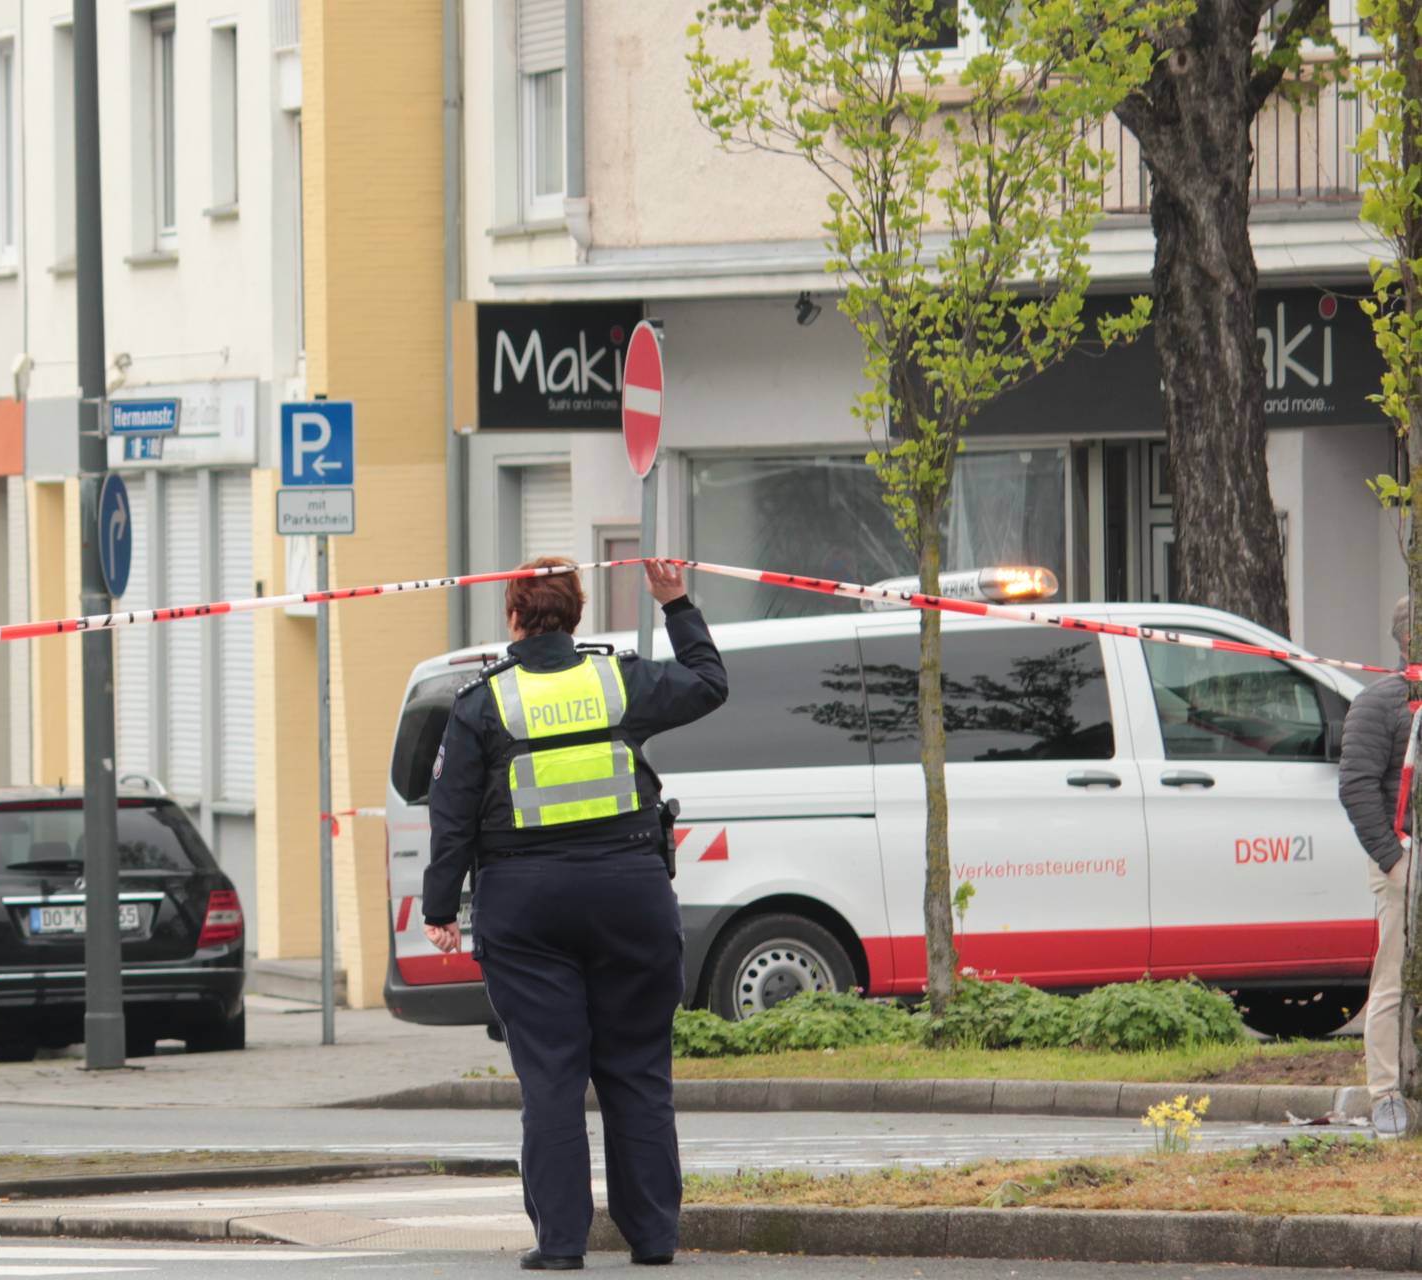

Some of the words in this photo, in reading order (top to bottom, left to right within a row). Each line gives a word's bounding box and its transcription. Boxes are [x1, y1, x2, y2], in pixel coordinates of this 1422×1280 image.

[493, 325, 622, 394] Maki
[573, 398, 592, 411] and
[1264, 396, 1289, 414] and
[1291, 397, 1335, 414] more...
[113, 405, 174, 428] Hermannstr.
[292, 412, 331, 477] P
[308, 499, 326, 510] mit
[283, 513, 348, 527] Parkschein
[530, 697, 602, 729] POLIZEI
[1235, 835, 1313, 864] DSW21
[955, 857, 1127, 879] Verkehrssteuerung
[42, 910, 63, 927] DO
